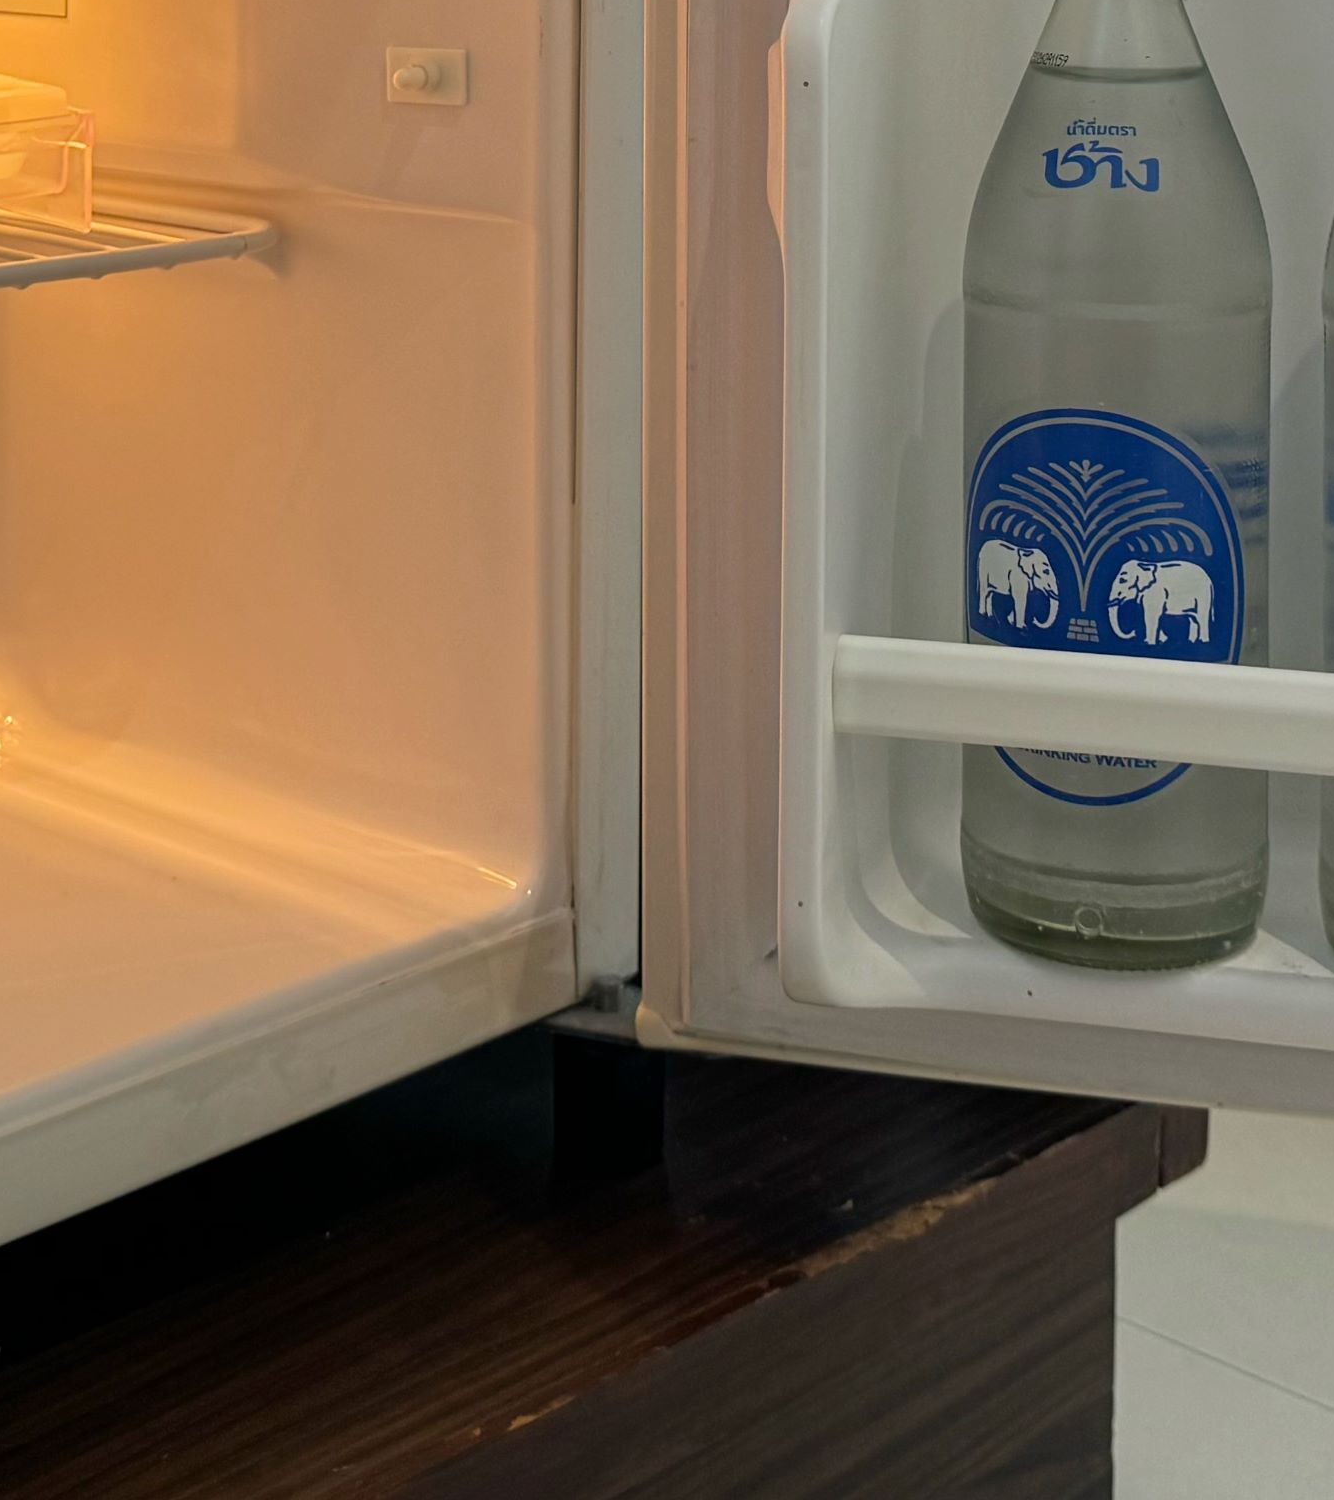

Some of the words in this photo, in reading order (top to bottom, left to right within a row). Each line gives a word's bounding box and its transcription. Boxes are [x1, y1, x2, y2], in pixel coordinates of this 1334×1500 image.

[1067, 116, 1136, 136] น้ำดื่มตรา
[1042, 140, 1159, 192] ช้าง
[1095, 754, 1157, 768] WATER
